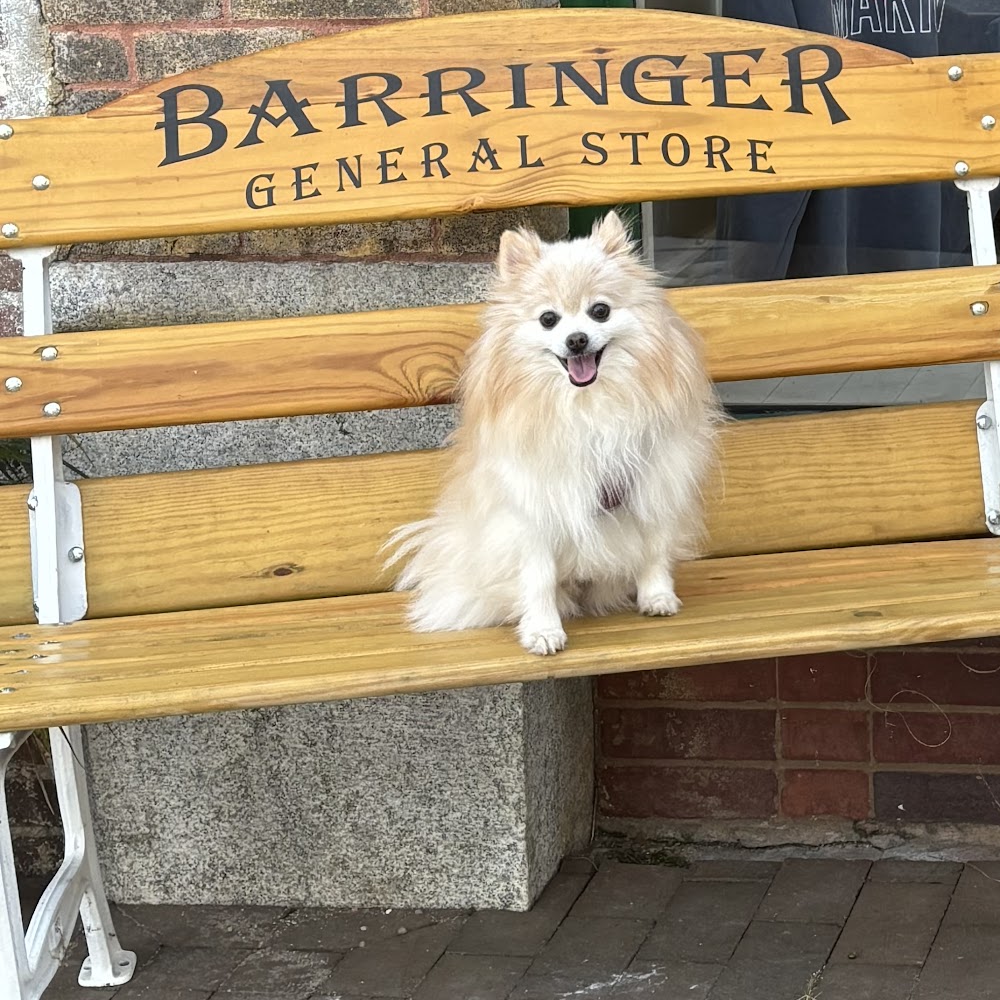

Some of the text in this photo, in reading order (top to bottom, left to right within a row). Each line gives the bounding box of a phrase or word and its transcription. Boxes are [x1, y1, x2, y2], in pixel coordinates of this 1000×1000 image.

[154, 43, 851, 168] BARRINGER
[245, 131, 776, 209] GENERAL STORE
